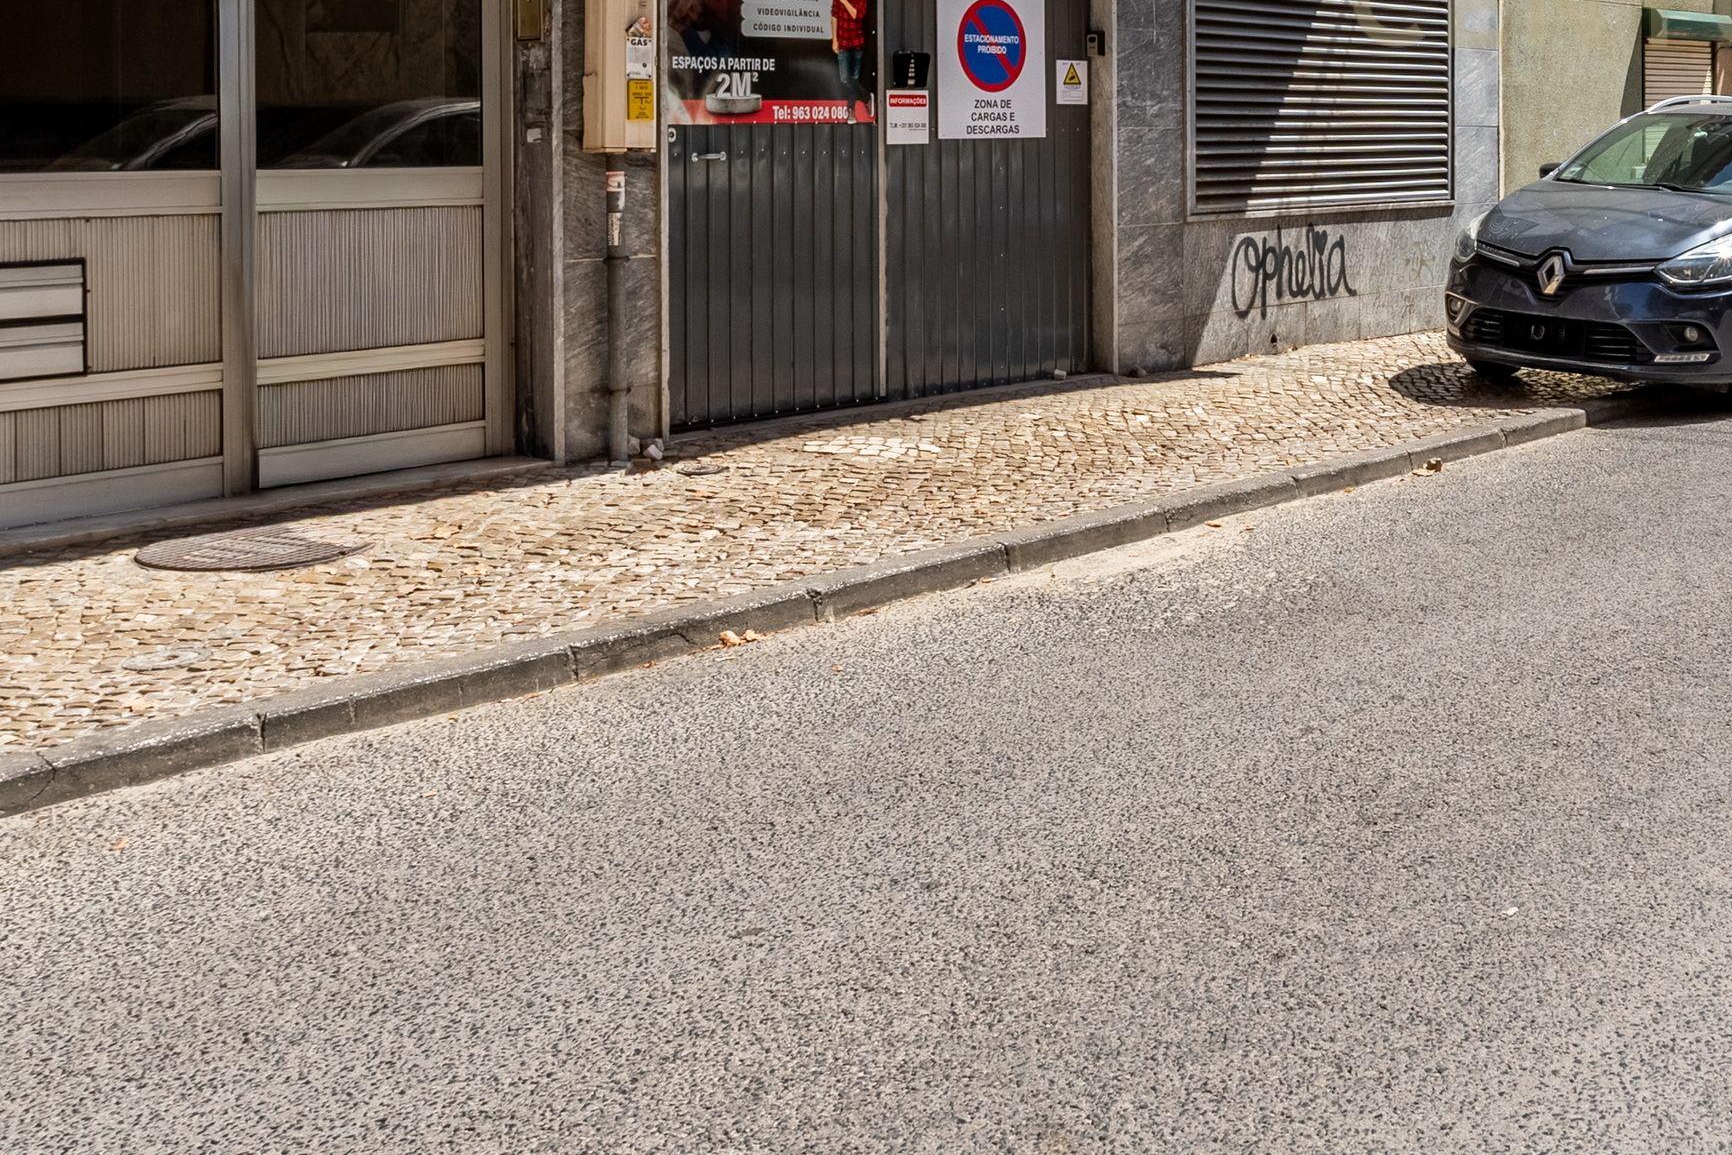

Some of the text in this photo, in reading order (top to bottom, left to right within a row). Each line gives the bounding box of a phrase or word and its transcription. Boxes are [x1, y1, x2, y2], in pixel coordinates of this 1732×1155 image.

[757, 8, 820, 18] VIDEOVIGILÂNCIA
[753, 22, 824, 34] CÓDIGO INDIVIDUAL
[964, 34, 1019, 44] ESTACIONAMENTO
[978, 45, 1007, 54] PROIBIDO
[672, 56, 775, 73] ESPAÇOS A PARTIR DE
[974, 99, 1012, 109] ZONA DE
[772, 106, 848, 120] Tel: 963 024 080
[971, 112, 1015, 122] CARGAS E
[966, 125, 1020, 135] DESCARGAS
[1231, 223, 1357, 320] Ophelia
